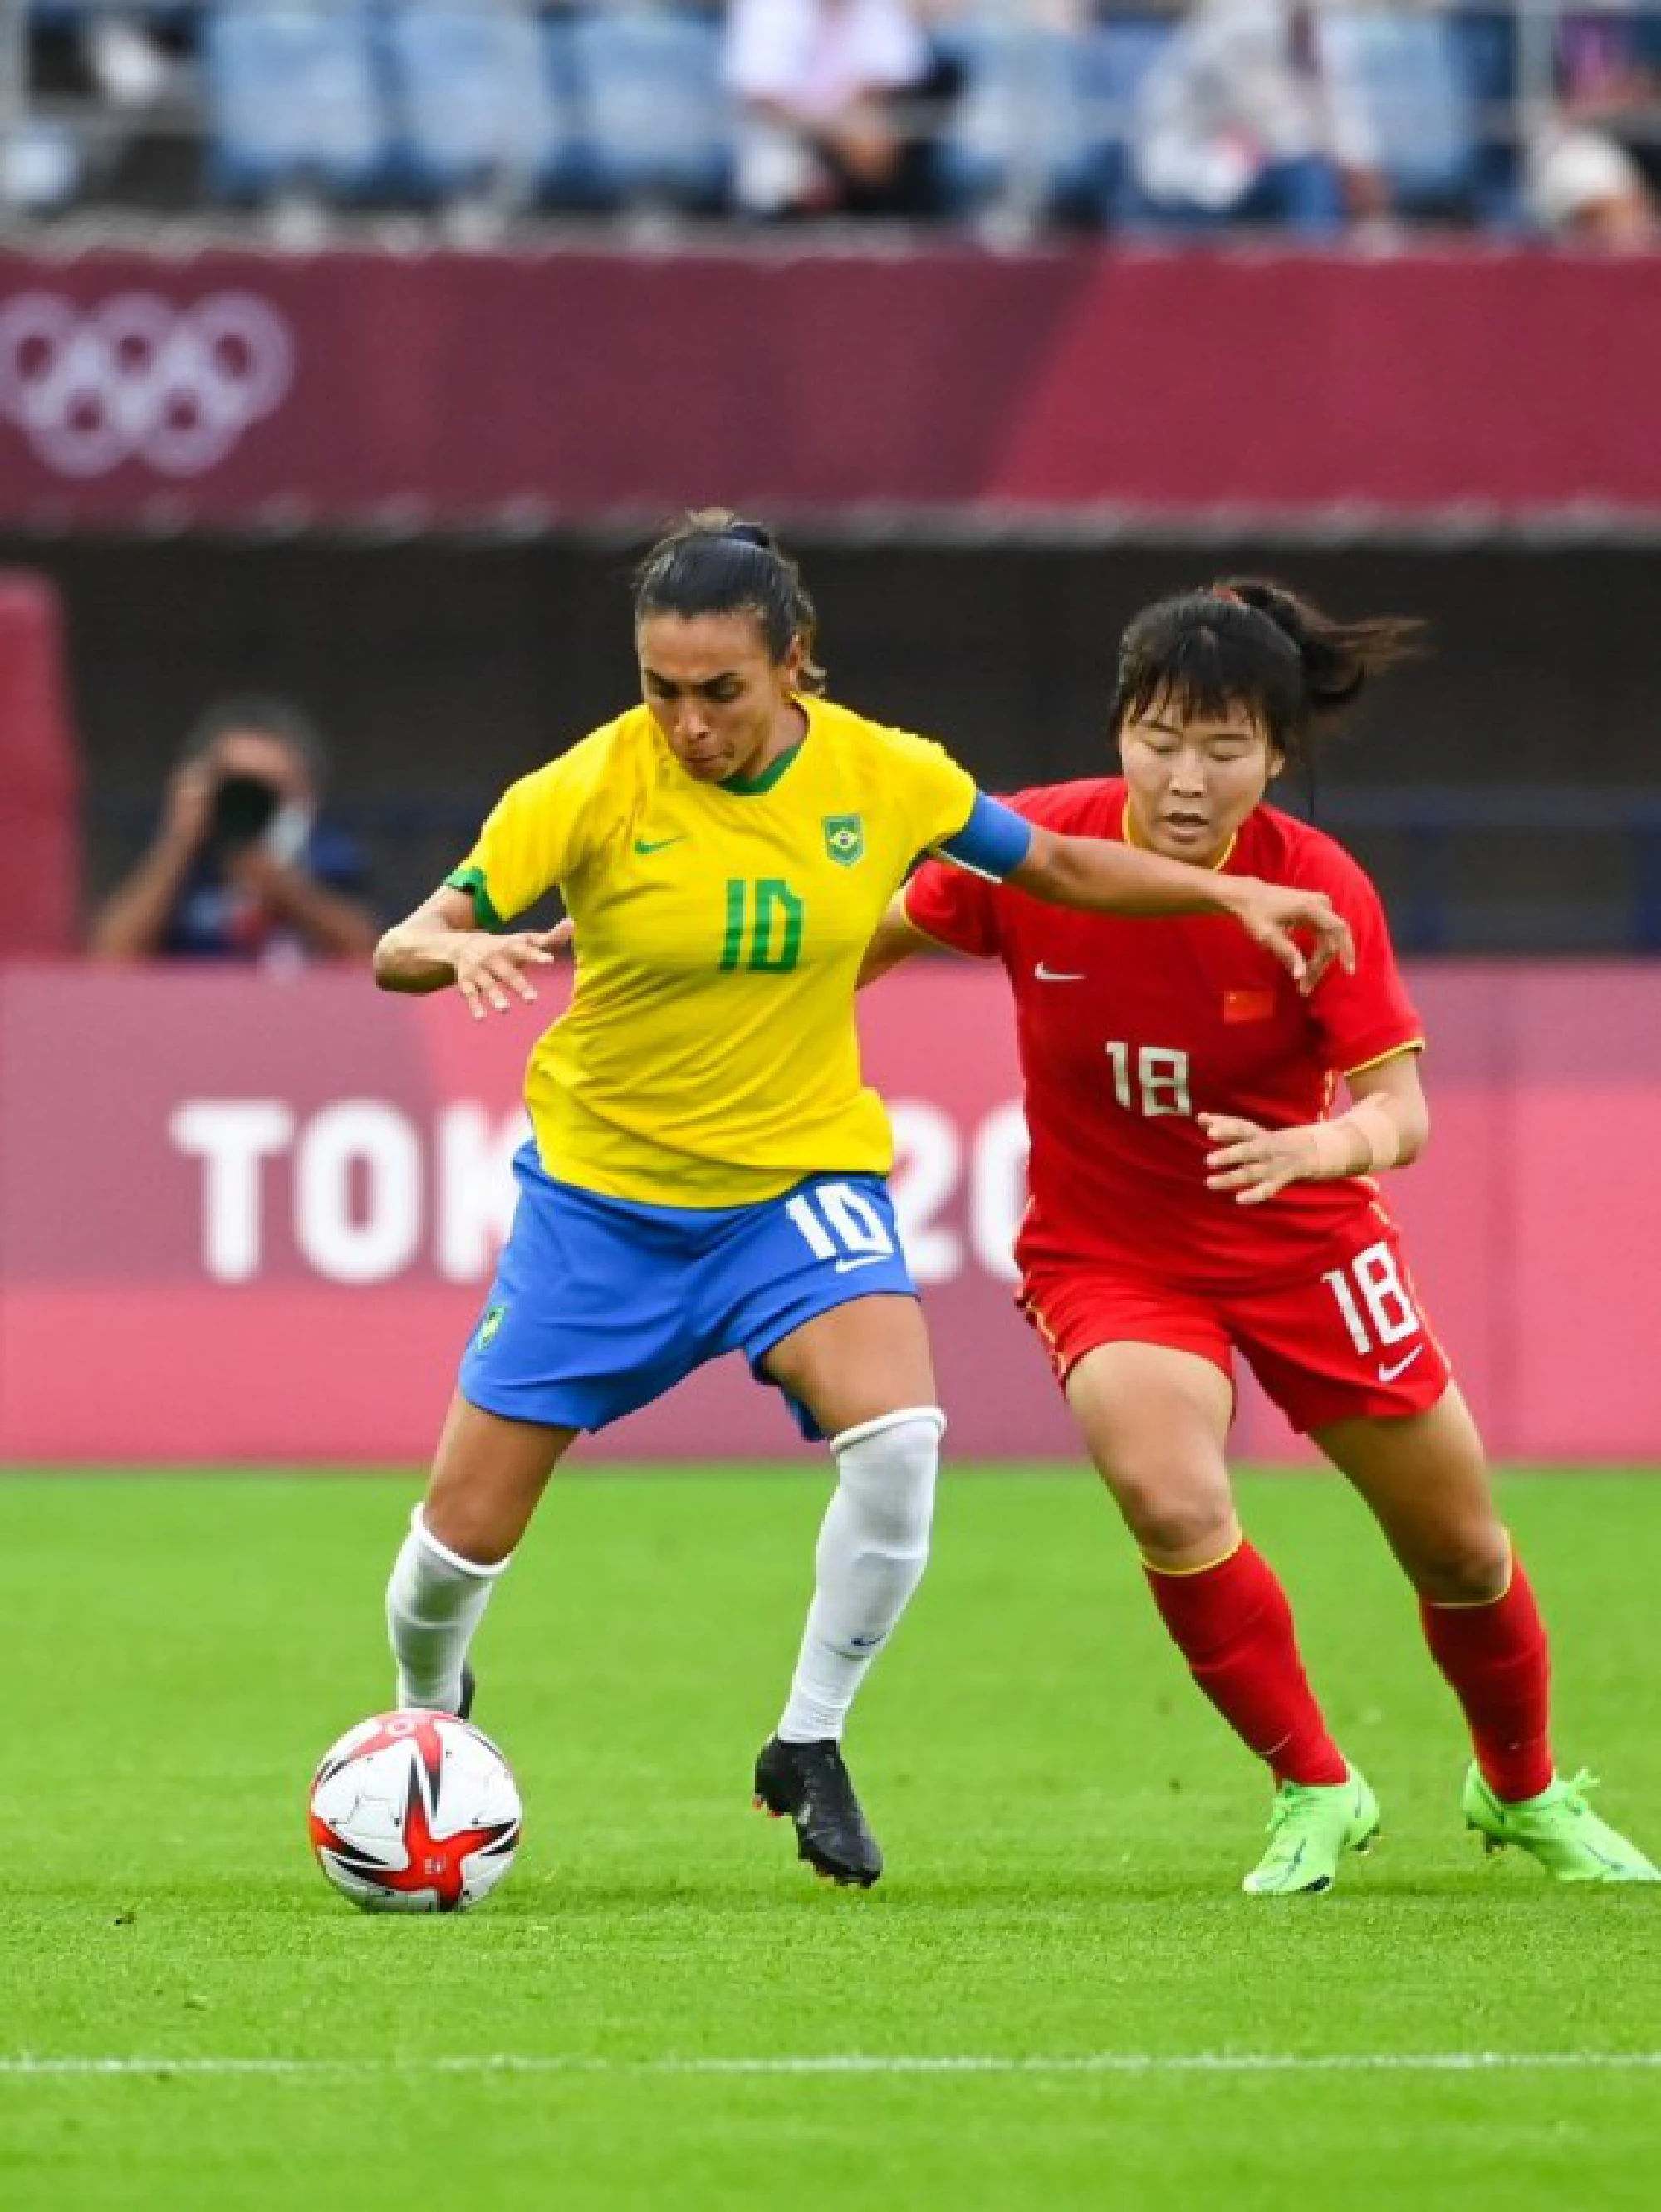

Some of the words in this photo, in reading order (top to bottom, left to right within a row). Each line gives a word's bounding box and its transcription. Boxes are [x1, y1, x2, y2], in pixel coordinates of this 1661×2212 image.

[719, 880, 805, 974] 10
[1105, 1041, 1192, 1116] 18
[169, 1098, 532, 1284] TOK
[890, 1098, 1032, 1283] 20
[785, 1182, 894, 1260] 10
[1320, 1241, 1419, 1355] 18
